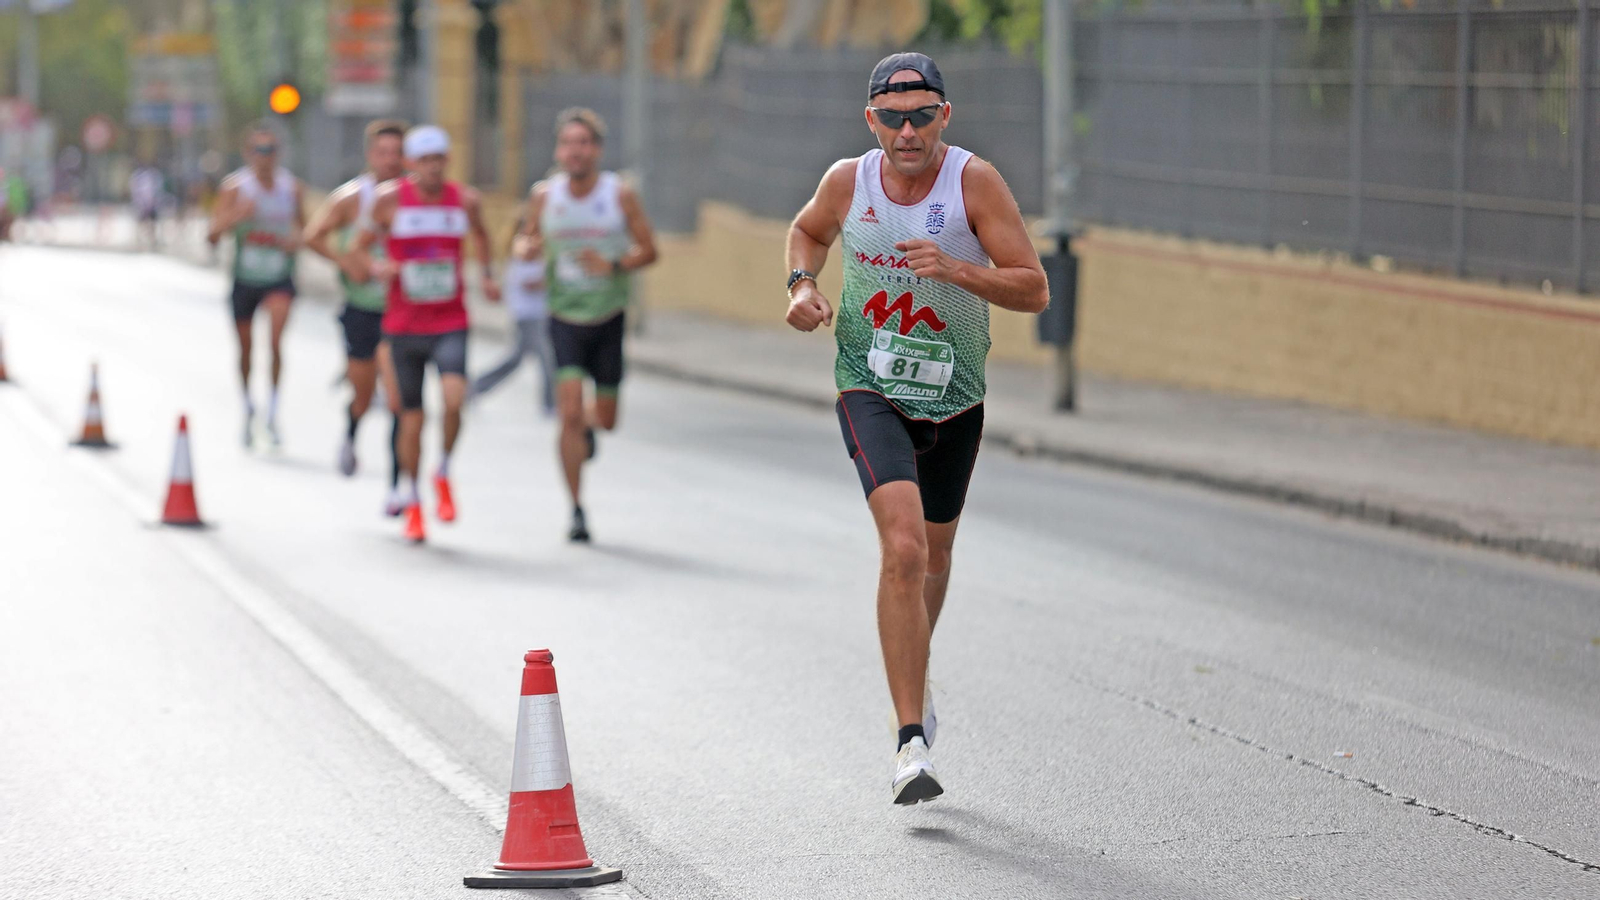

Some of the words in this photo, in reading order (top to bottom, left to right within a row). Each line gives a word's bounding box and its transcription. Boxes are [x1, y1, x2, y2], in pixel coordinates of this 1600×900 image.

[856, 251, 910, 269] mara
[880, 275, 921, 285] JEREZ
[891, 358, 921, 379] 81
